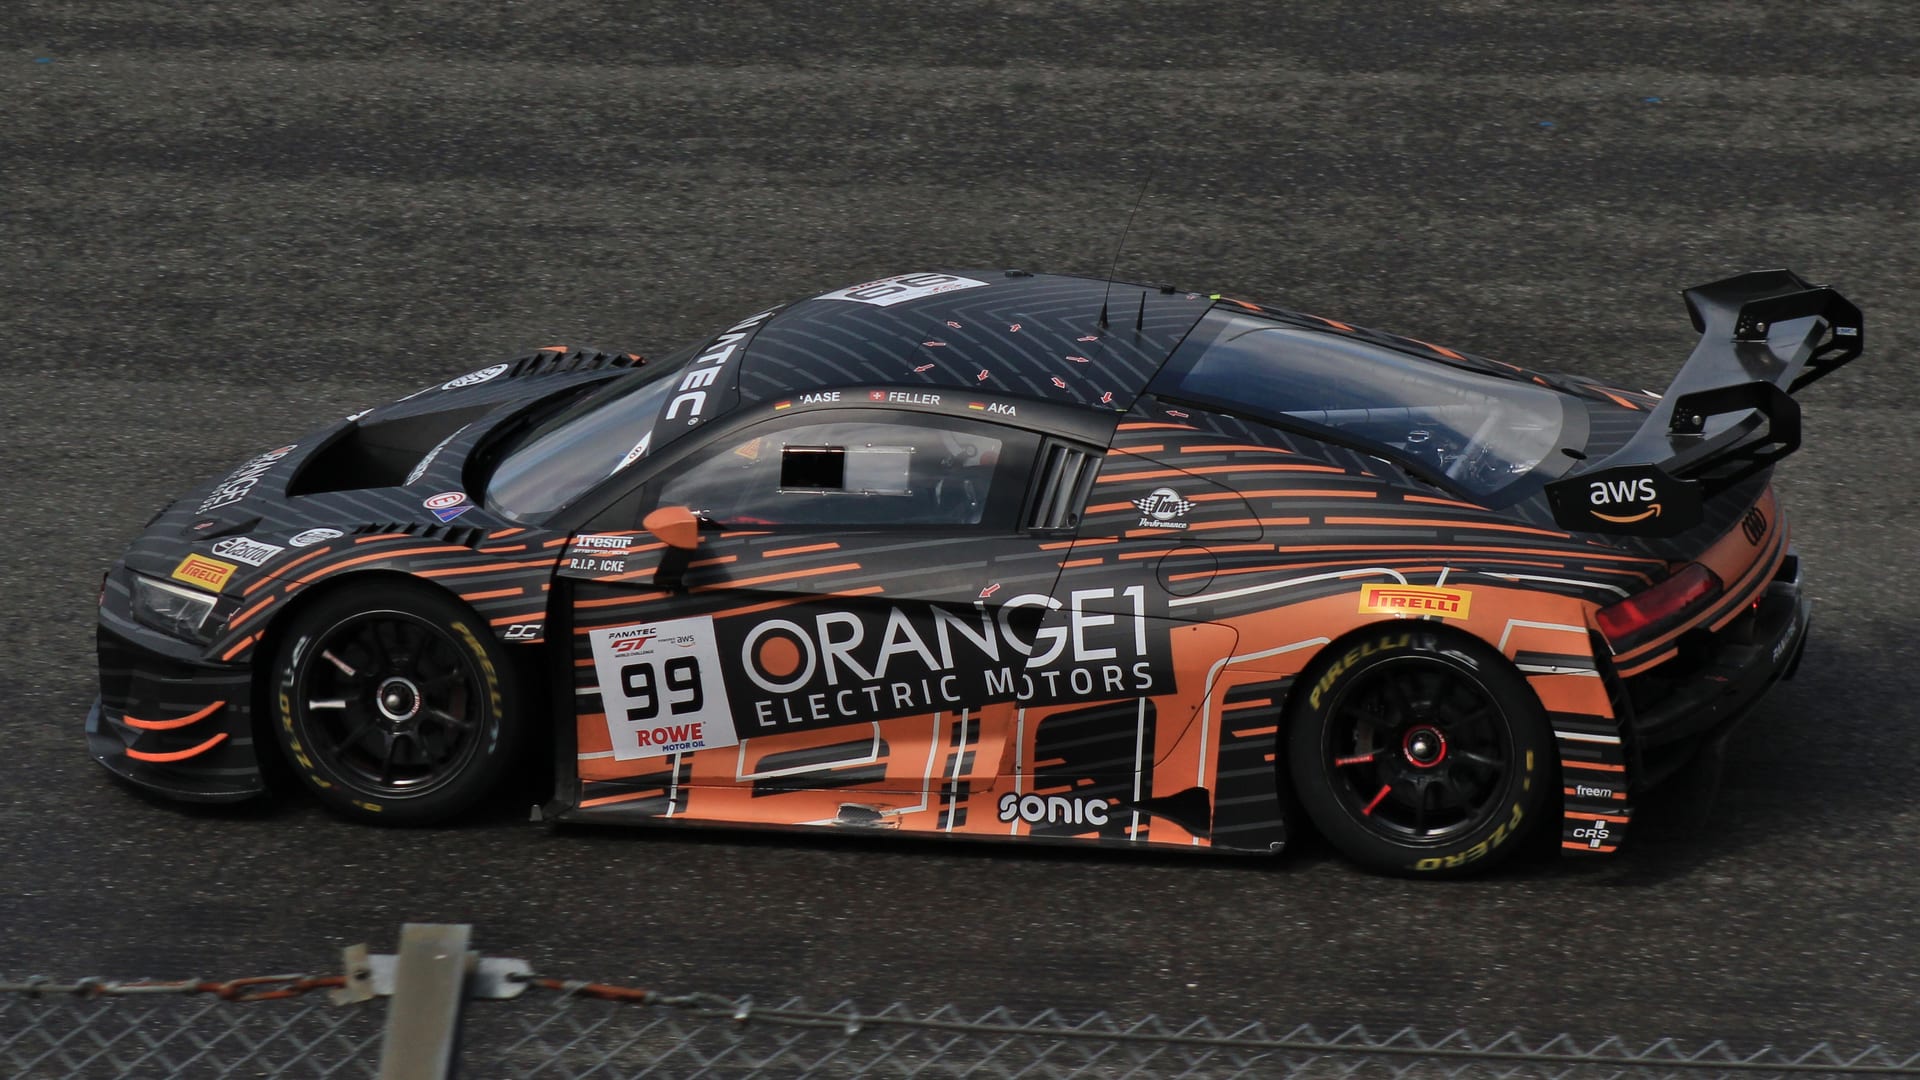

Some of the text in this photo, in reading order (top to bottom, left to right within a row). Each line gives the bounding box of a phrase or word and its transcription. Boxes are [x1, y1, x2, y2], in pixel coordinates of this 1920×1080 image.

[799, 390, 841, 405] AASE
[888, 391, 941, 406] FELLER
[986, 401, 1017, 417] AKA
[1589, 477, 1657, 505] aws
[226, 539, 275, 563] Castrol
[575, 534, 634, 549] Tresor
[180, 558, 229, 585] PIRELLI
[570, 558, 625, 573] R.I.P. ICKE
[1368, 589, 1462, 613] PIRELLI
[608, 627, 657, 640] FANATEC
[610, 635, 658, 653] GT
[676, 634, 695, 645] aws
[741, 585, 1148, 694] ORANGE1
[983, 661, 1153, 701] MOTORS
[1308, 633, 1412, 712] PIRELLI
[620, 655, 704, 722] 99
[754, 675, 961, 727] ELECTRIC
[636, 722, 704, 748] ROWE
[662, 740, 705, 753] MOTOR OIL
[1575, 784, 1612, 798] freem
[1572, 827, 1611, 840] CRS
[1414, 822, 1509, 872] ZERO
